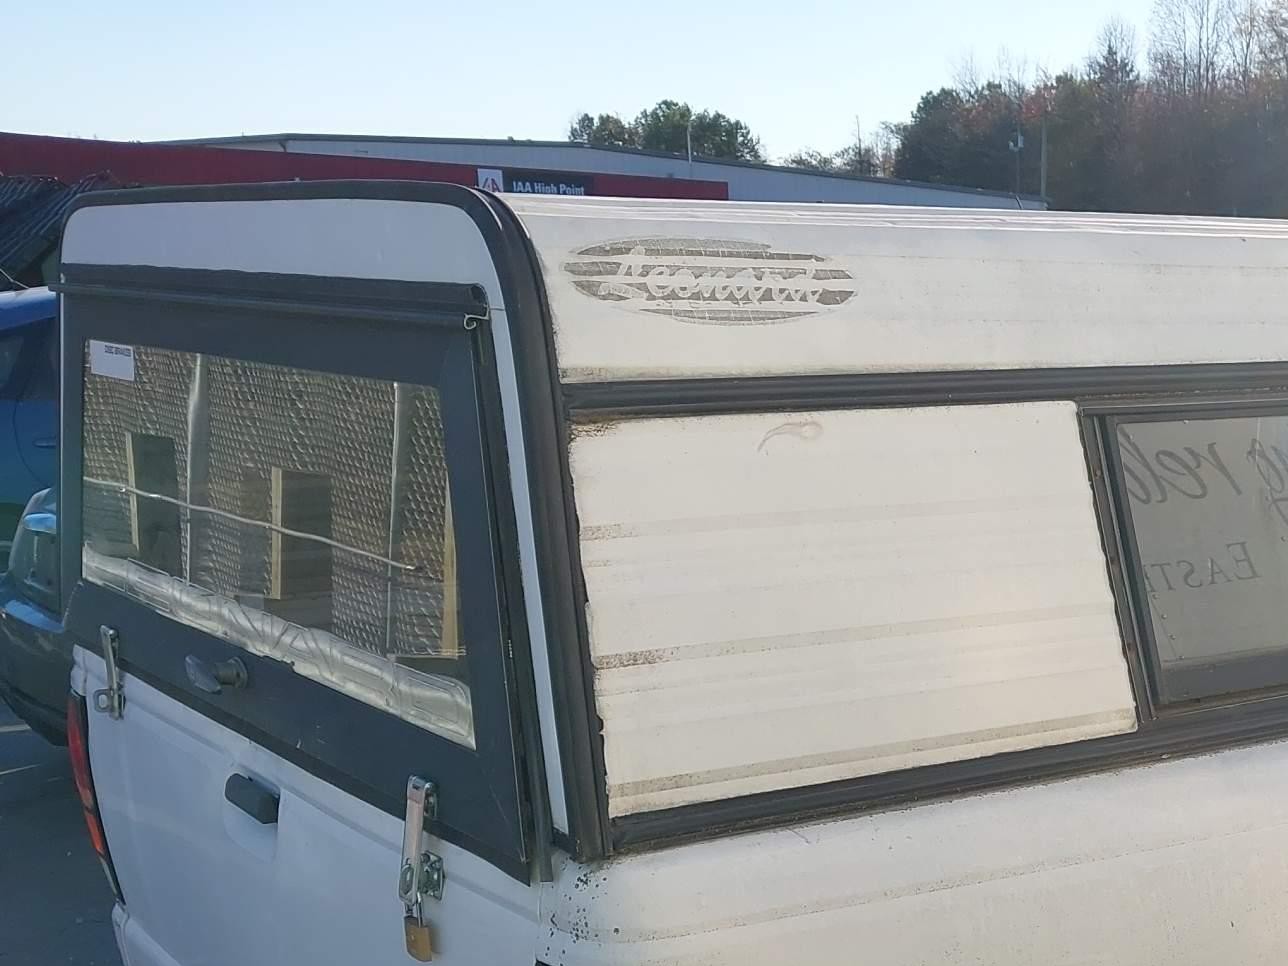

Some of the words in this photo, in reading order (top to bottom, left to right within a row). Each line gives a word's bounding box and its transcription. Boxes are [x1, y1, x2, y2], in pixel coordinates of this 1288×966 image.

[513, 181, 532, 193] IAA
[534, 182, 557, 195] High
[560, 183, 584, 196] Point
